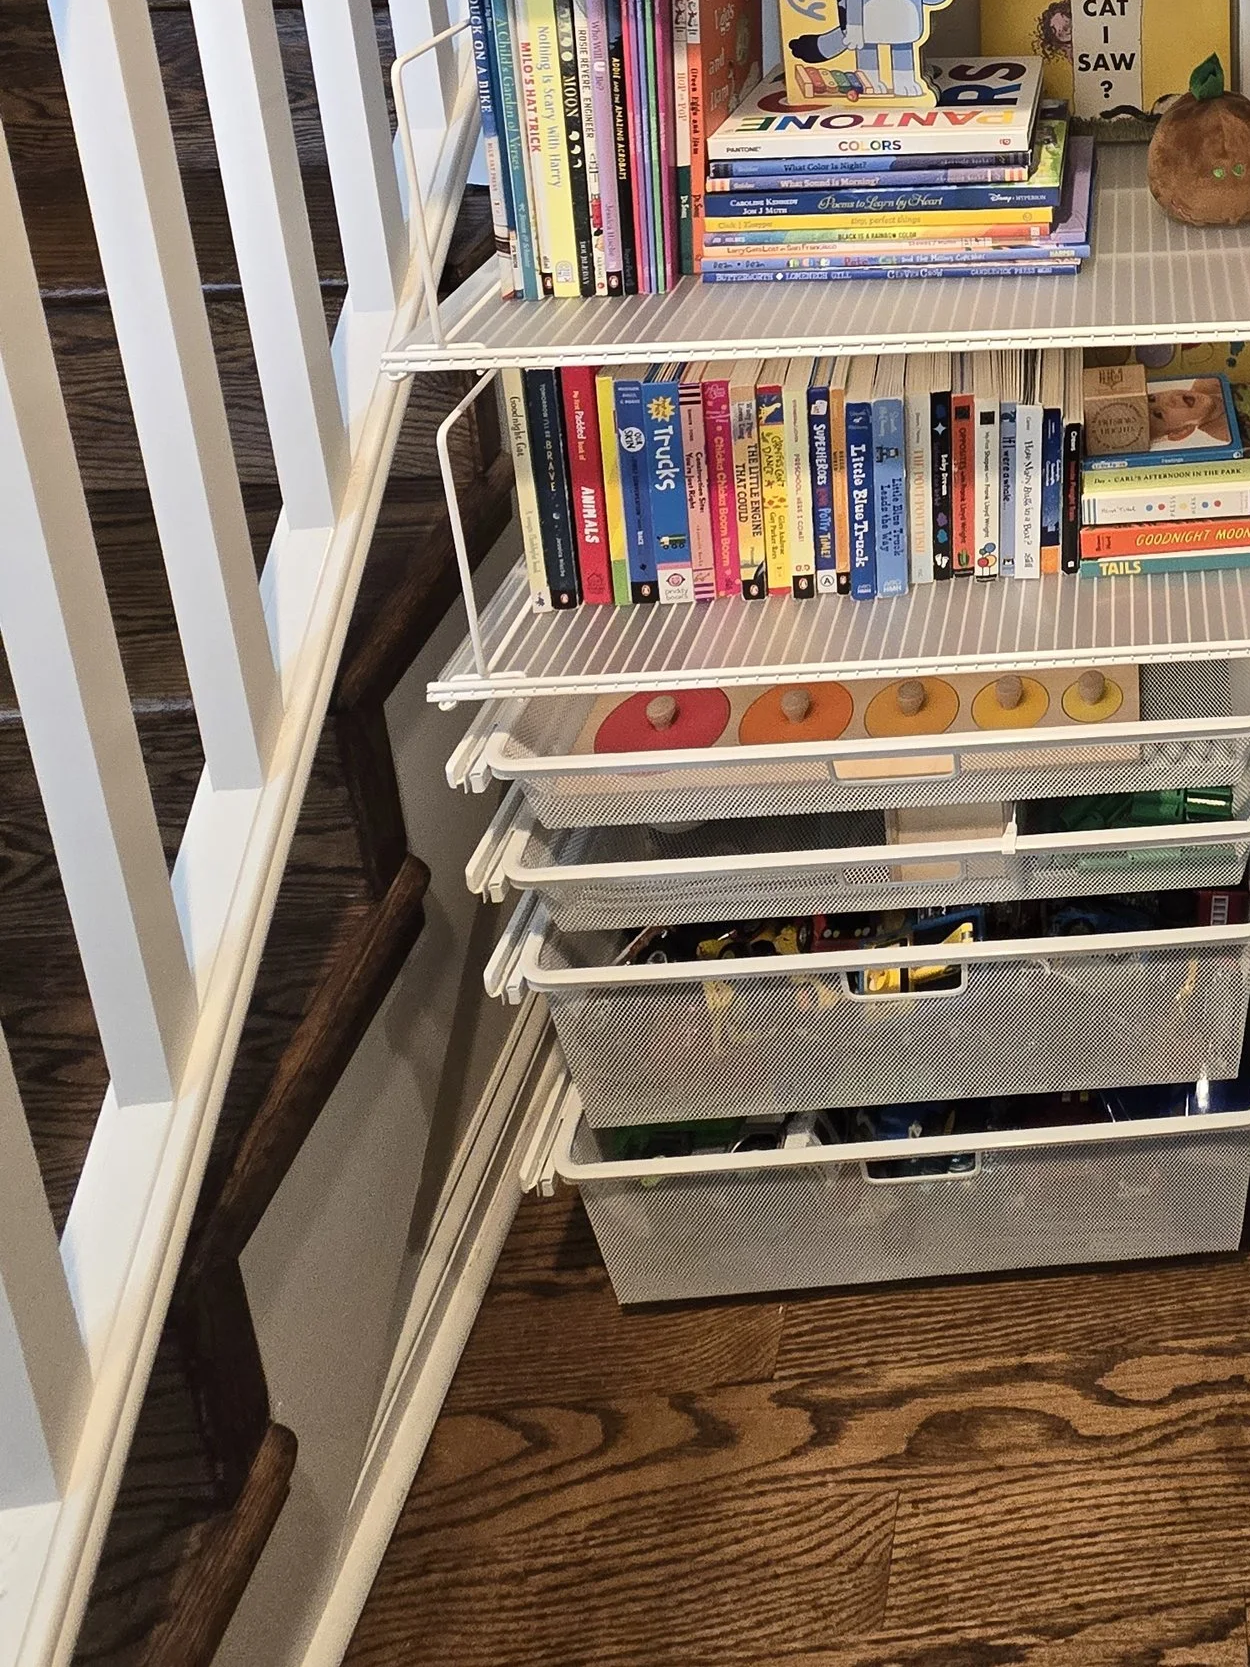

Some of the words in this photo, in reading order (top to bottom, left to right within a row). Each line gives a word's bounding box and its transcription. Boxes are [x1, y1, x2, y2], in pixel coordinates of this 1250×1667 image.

[537, 26, 552, 70] Nothing
[579, 30, 588, 55] ROSIE
[1103, 26, 1108, 44] I
[474, 40, 486, 61] ON
[520, 42, 534, 85] MILO'S
[709, 47, 725, 75] and
[1077, 53, 1135, 72] SAW
[580, 58, 590, 92] REVERE,
[479, 80, 491, 113] BIKE
[526, 89, 537, 113] HAT
[563, 75, 578, 118] MOON
[1100, 81, 1113, 99] ?
[542, 88, 557, 121] Scary
[583, 98, 594, 138] ENGINEER
[529, 117, 540, 152] TRICK
[547, 125, 560, 149] With
[838, 140, 901, 151] COLORS
[548, 154, 562, 188] Harry
[784, 163, 804, 172] What
[807, 163, 829, 171] Color
[840, 161, 866, 171] Night?
[730, 199, 764, 207] CAROLINE
[624, 430, 635, 449] SKIN
[714, 437, 725, 470] Chicka
[748, 443, 758, 463] THE
[654, 425, 680, 491] Trucks
[850, 445, 866, 486] Little
[575, 411, 586, 439] Padded
[581, 486, 599, 544] ANIMALS
[716, 472, 727, 506] Chicka
[736, 464, 746, 488] THAT
[749, 466, 759, 498] LITTLE
[1114, 475, 1142, 483] CARL'S
[1143, 472, 1190, 481] AFTERNOON
[1204, 470, 1219, 478] THE
[1220, 468, 1242, 476] PARK
[853, 489, 867, 520] Blue
[881, 485, 891, 512] Leads
[892, 478, 902, 503] Little
[738, 491, 748, 522] COULD
[751, 500, 762, 536] ENGINE
[893, 505, 902, 526] Blue
[719, 507, 729, 536] Boom
[882, 514, 891, 530] the
[721, 538, 731, 566] Boom
[854, 520, 869, 567] Truck
[880, 533, 891, 553] Way
[893, 529, 903, 557] Truck
[1136, 529, 1212, 547] GOODNIGHT
[1099, 560, 1142, 576] TAILS
